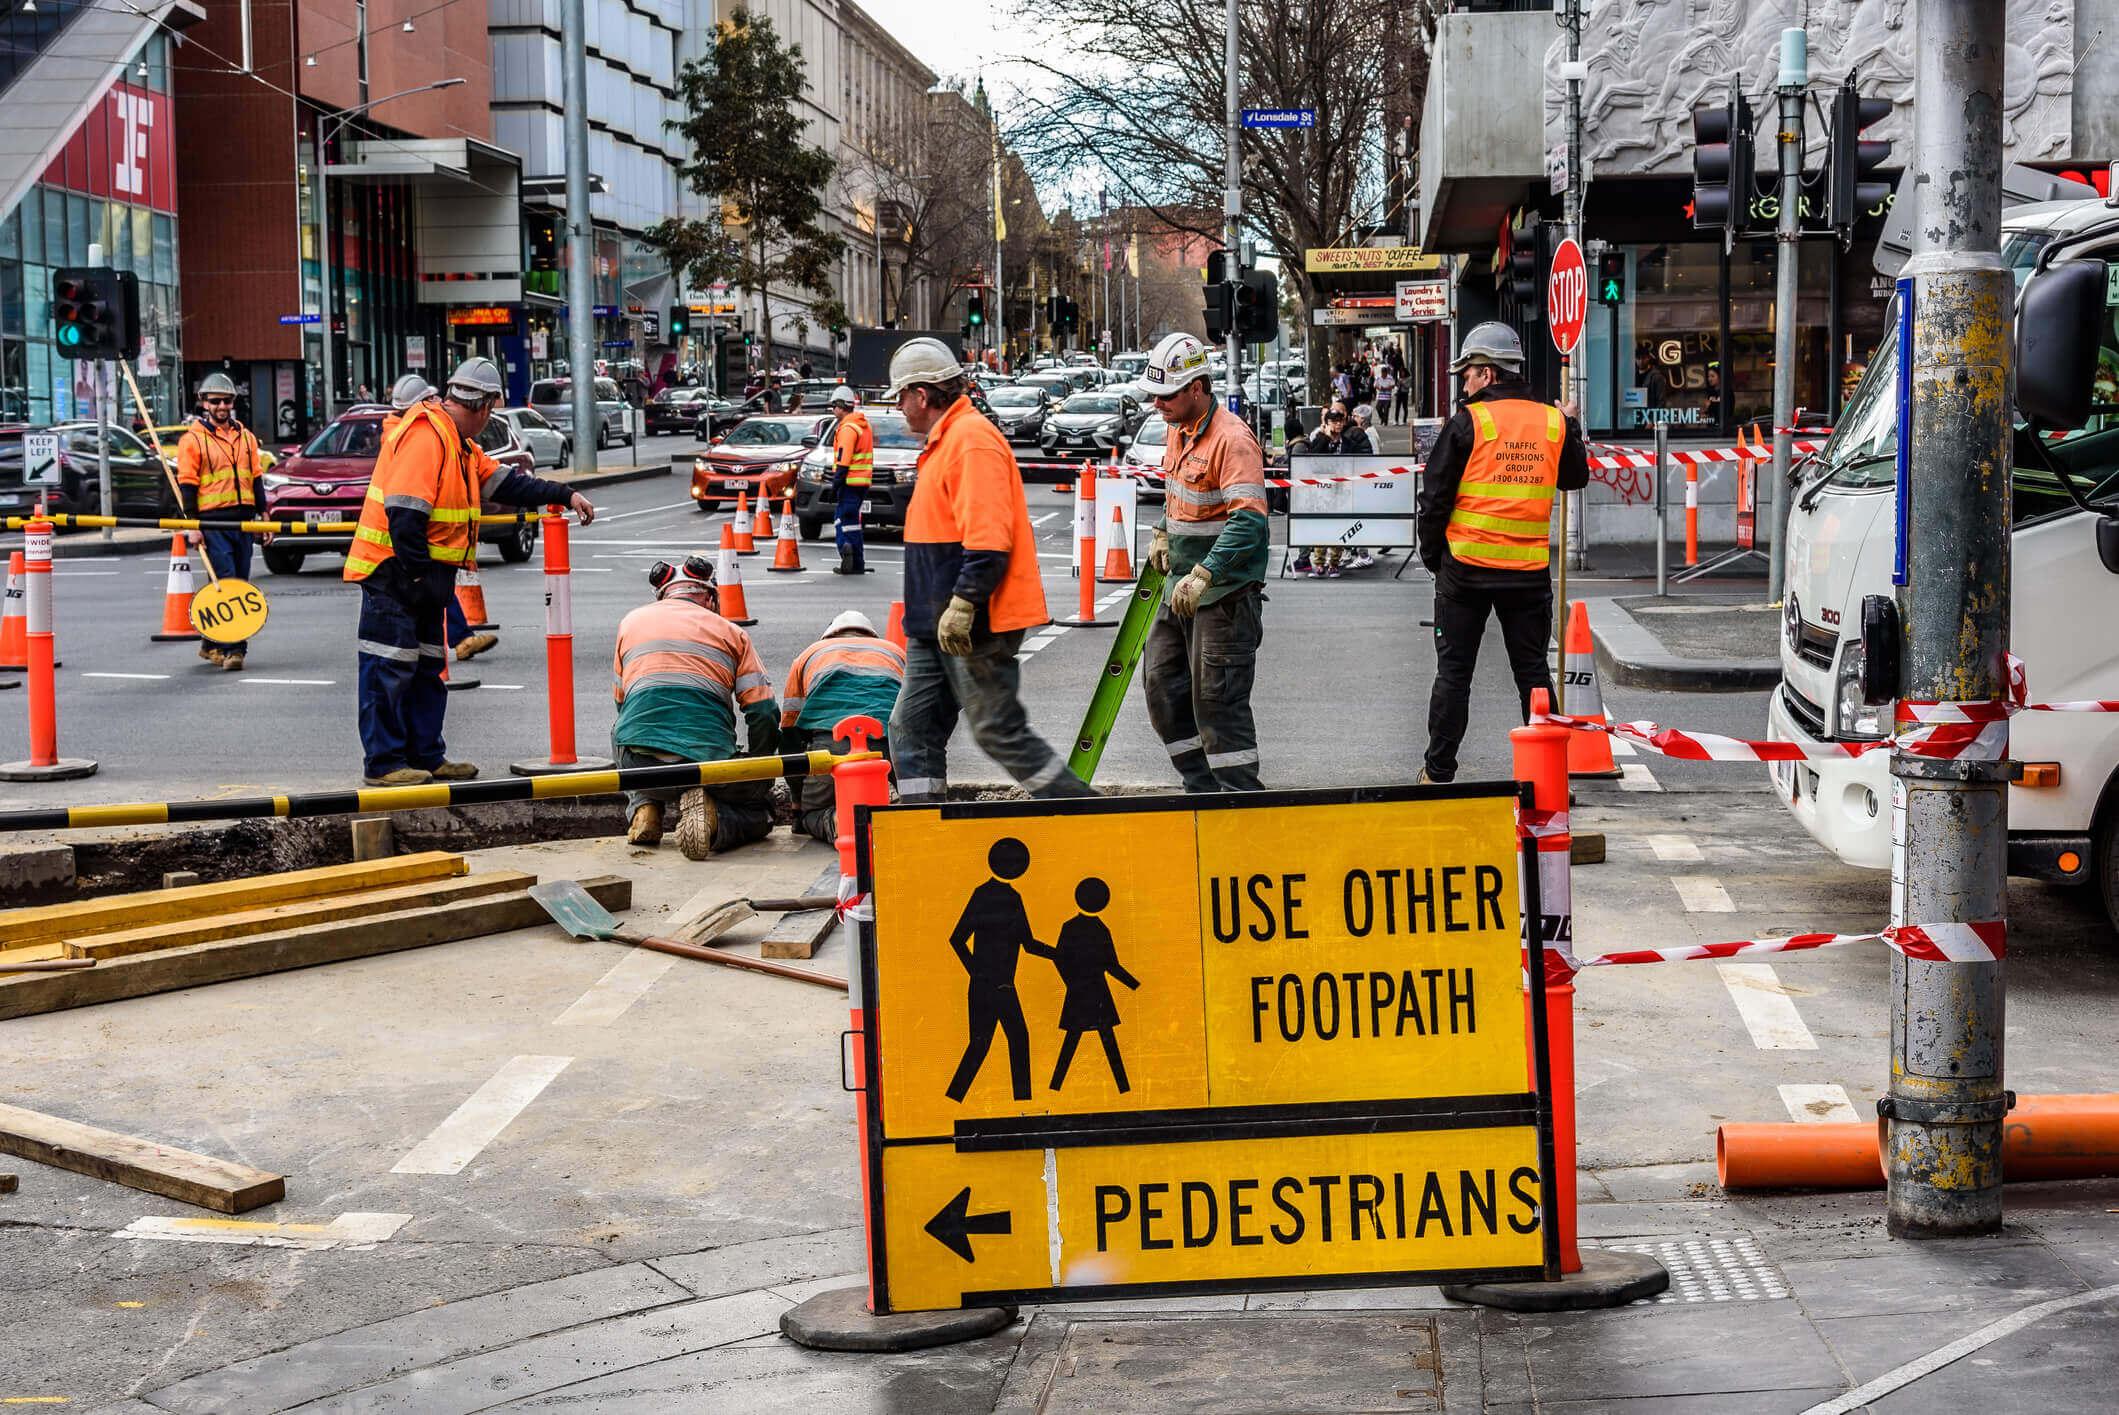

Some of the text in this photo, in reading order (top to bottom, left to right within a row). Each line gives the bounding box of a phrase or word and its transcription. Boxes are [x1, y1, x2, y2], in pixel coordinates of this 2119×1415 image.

[1255, 112, 1312, 121] Lonsdale St
[1316, 251, 1352, 262] SWEETS
[1404, 285, 1442, 296] Laundry &
[1551, 266, 1583, 326] STOP
[1401, 298, 1413, 307] Dry
[1415, 296, 1446, 305] Cleaning
[1411, 306, 1436, 315] Service
[1633, 407, 1701, 424] EXTREME
[30, 438, 53, 447] KEEP
[1504, 441, 1537, 450] TRAFFIC
[31, 447, 52, 457] LEFT
[1496, 452, 1545, 462] DIVERSIONS
[1505, 464, 1534, 473] GROUP
[1493, 474, 1512, 483] 1300
[198, 592, 262, 630] SLOW
[1821, 607, 1841, 626] 300
[1211, 874, 1308, 944] USE
[1343, 865, 1505, 936] OTHER
[1251, 969, 1476, 1043] FOOTPATH
[1095, 1166, 1540, 1253] PEDESTRIANS
